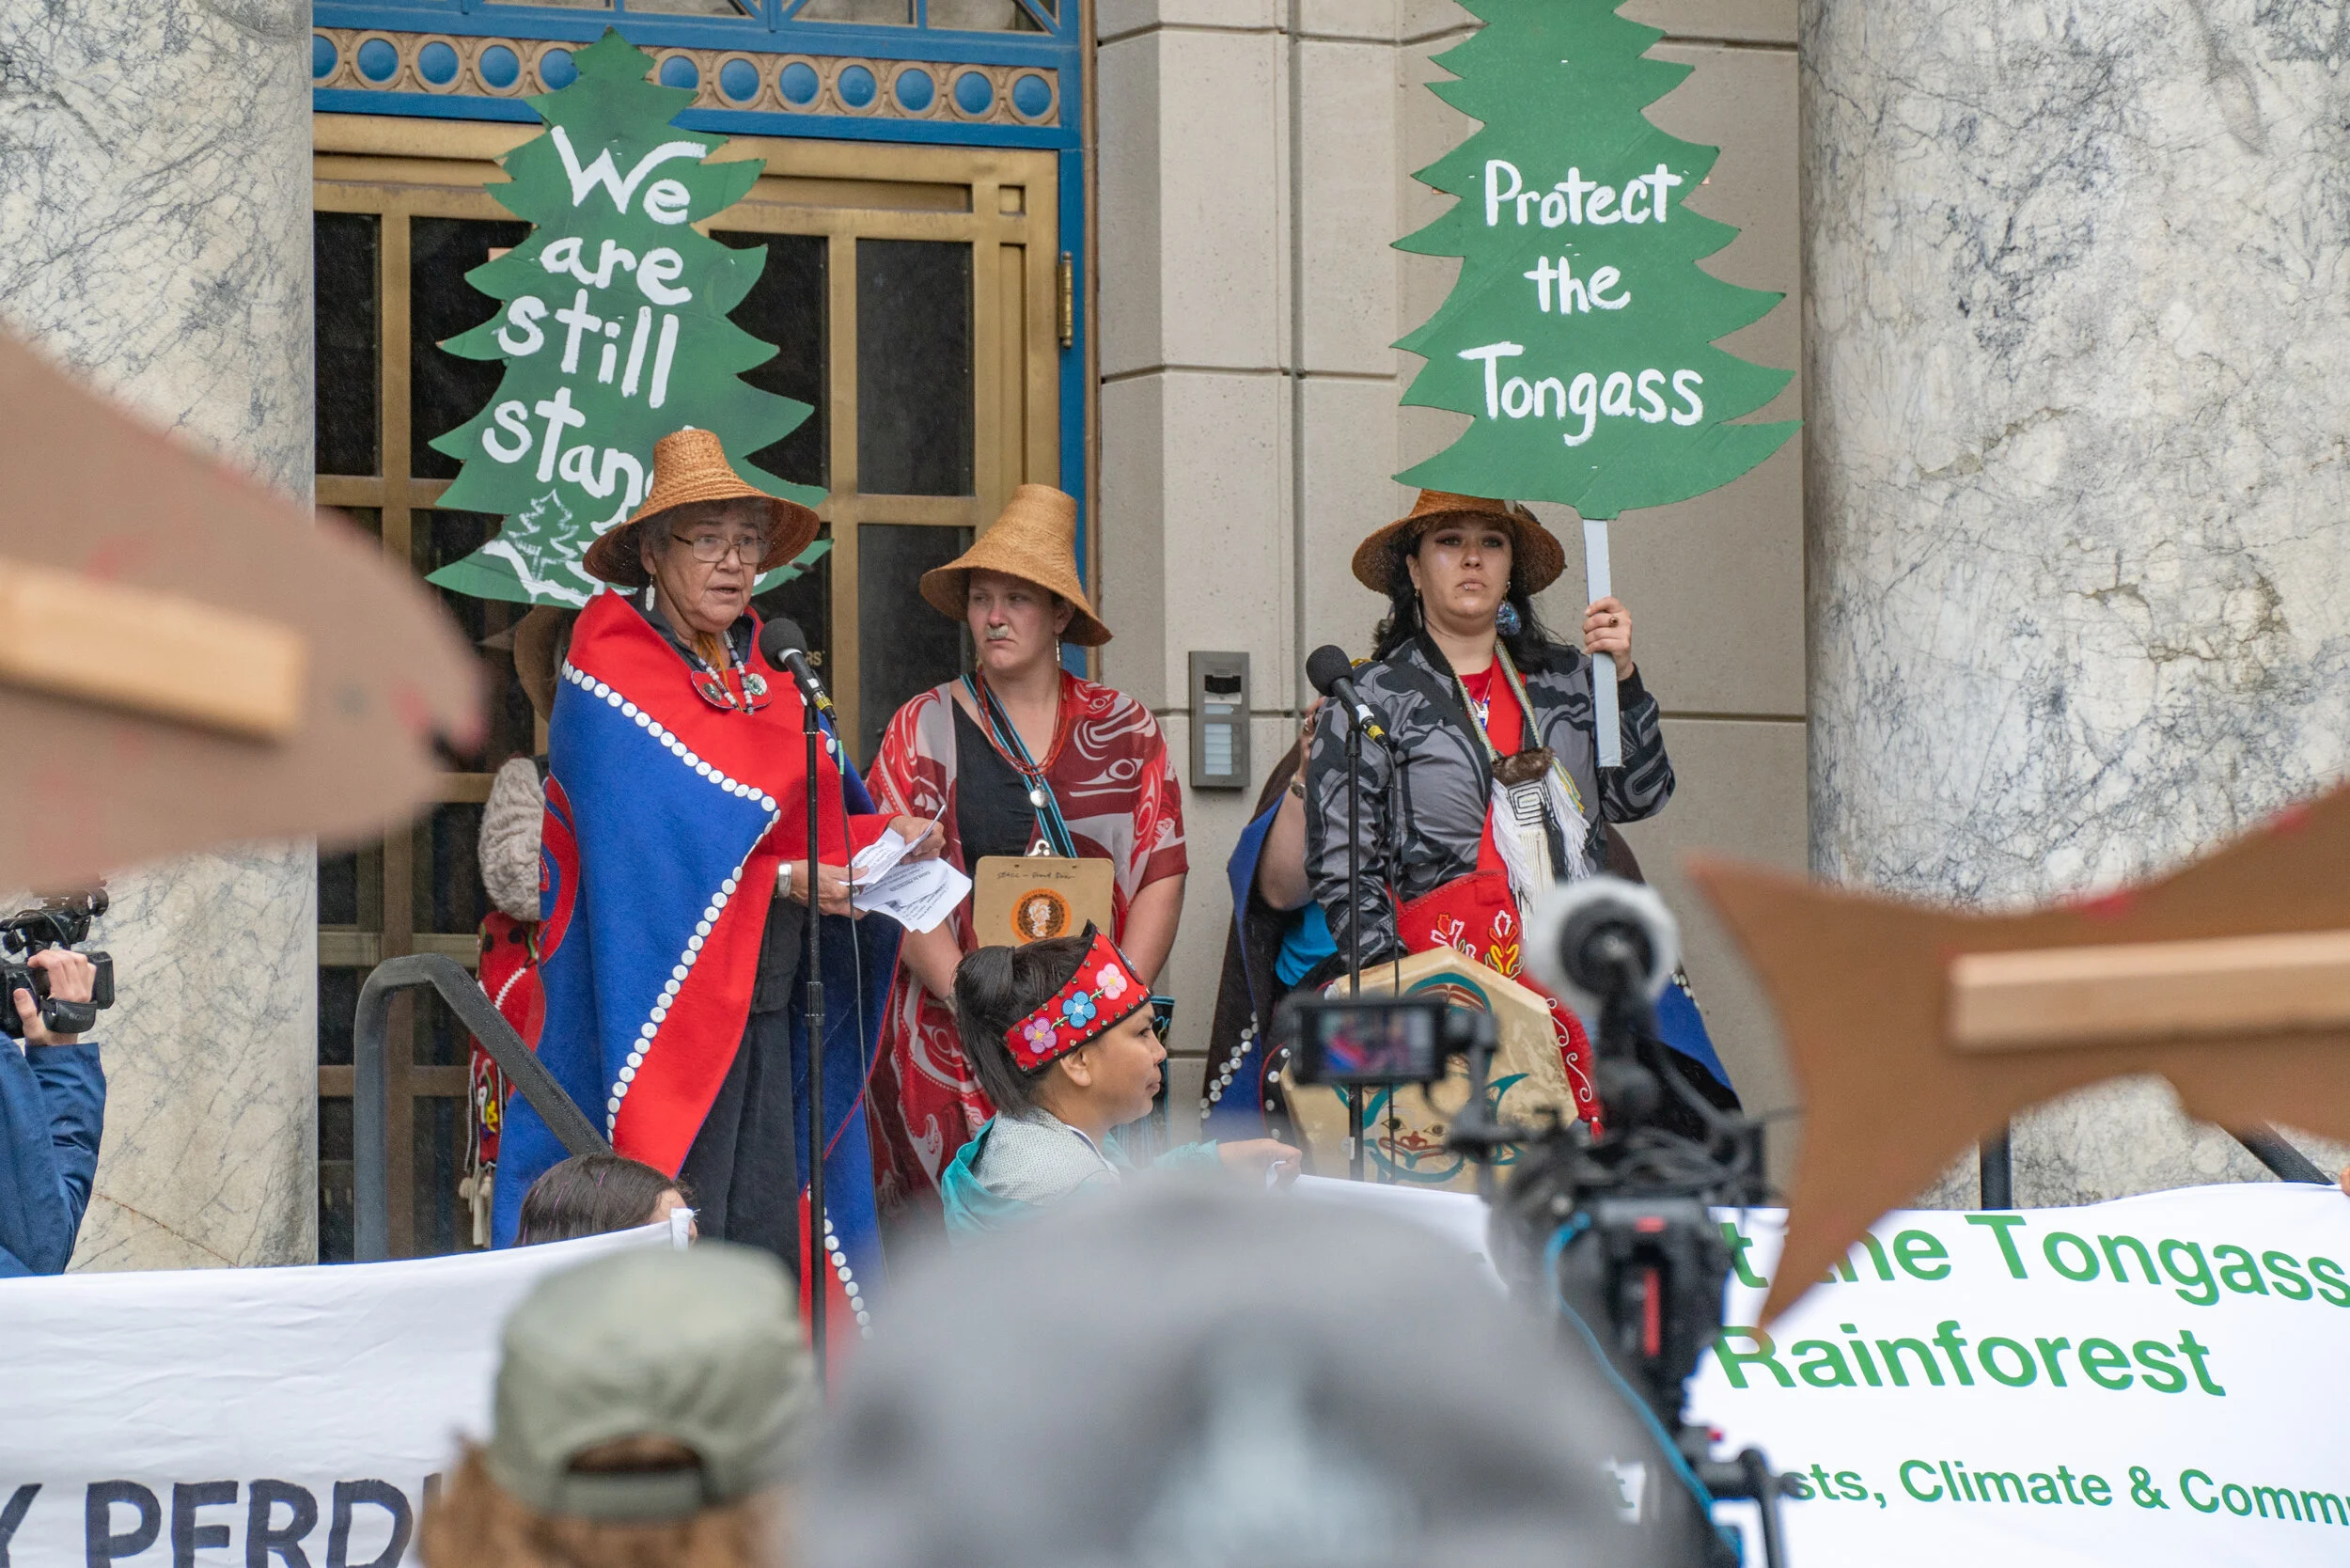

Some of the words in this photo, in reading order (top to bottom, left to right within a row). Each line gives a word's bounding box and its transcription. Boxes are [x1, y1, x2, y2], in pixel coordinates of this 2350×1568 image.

[550, 125, 707, 225] We
[1485, 159, 1683, 227] Protect
[540, 237, 693, 306] are
[1524, 256, 1631, 314] the
[495, 289, 679, 409] still
[1458, 341, 1703, 447] Tongass
[482, 386, 655, 509] stan
[1965, 1215, 2350, 1308] Tongass
[1712, 1320, 2227, 1397] Rainforest
[1899, 1460, 2113, 1506] Climate
[2128, 1466, 2170, 1510] &
[2179, 1468, 2350, 1527] Comm
